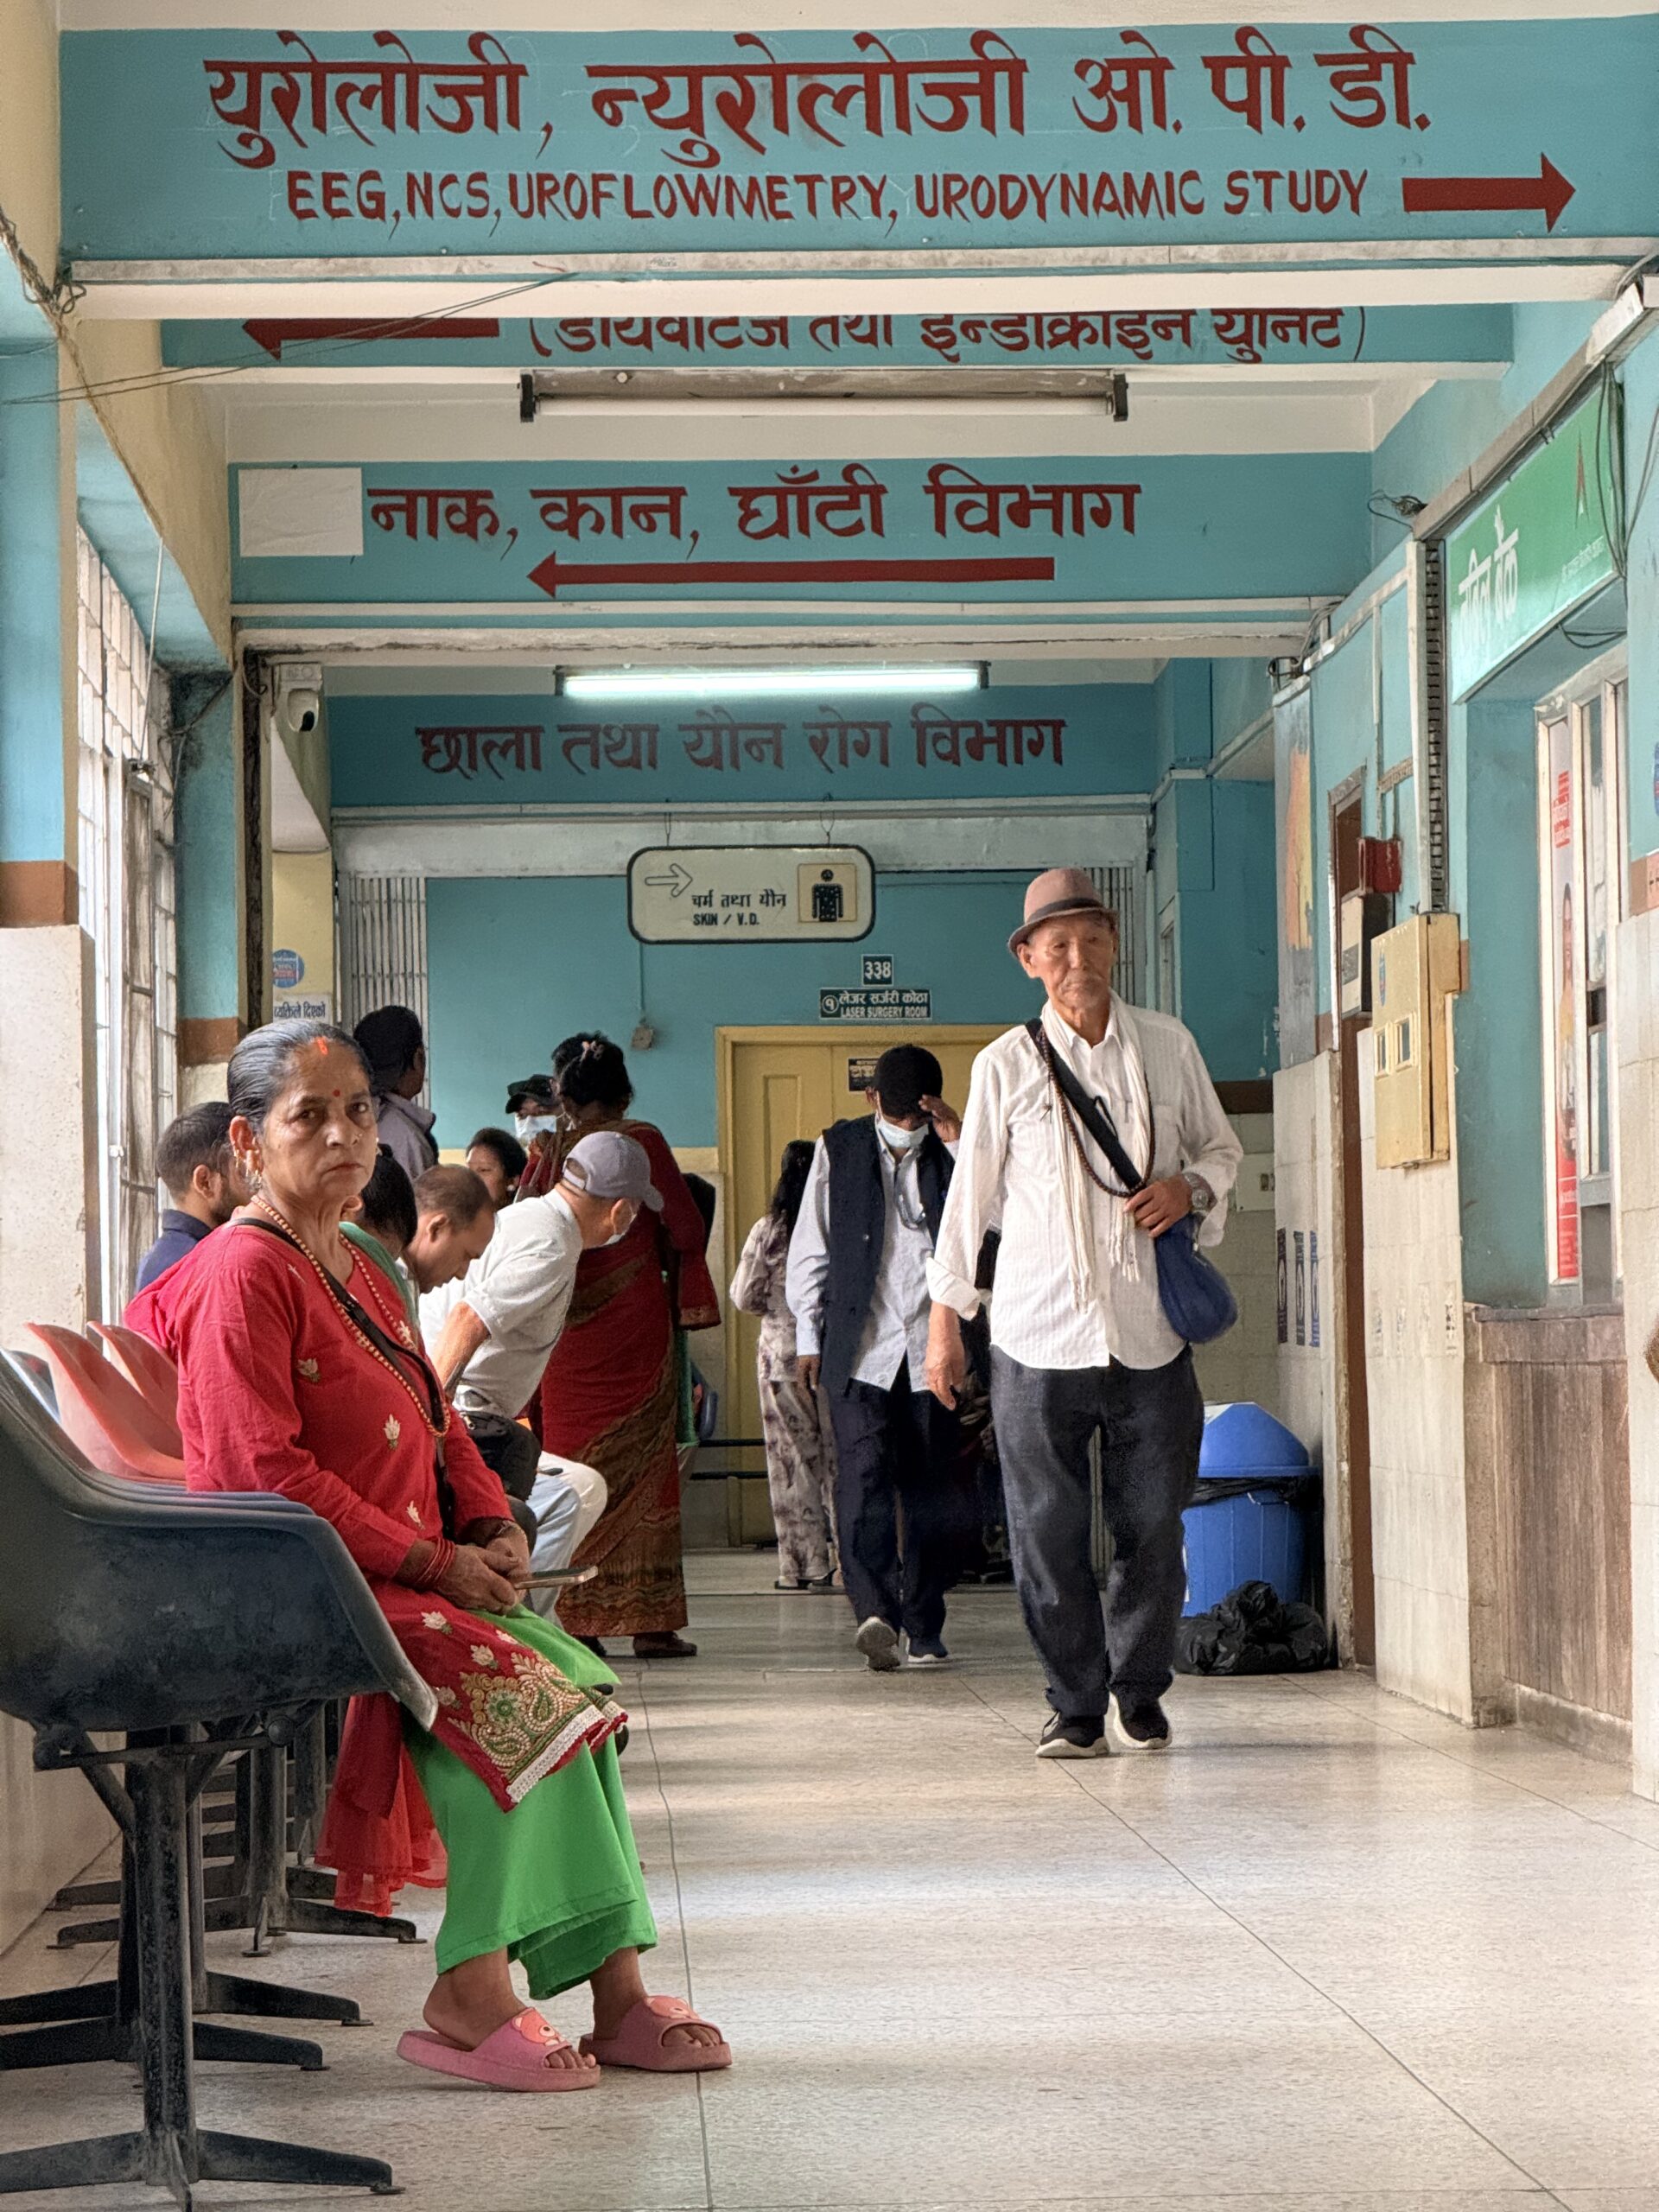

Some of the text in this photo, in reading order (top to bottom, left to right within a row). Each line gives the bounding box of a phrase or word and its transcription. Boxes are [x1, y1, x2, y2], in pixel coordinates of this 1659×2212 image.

[203, 23, 1431, 168] युरोलोजी, न्युरोलोजी ओ. पी. डी.
[916, 170, 1205, 222] URODYNAMIC
[1224, 168, 1369, 217] STUDY
[366, 462, 1141, 561] नाक, कान, घाँटी विभाग
[415, 702, 1068, 780] छाला तथा यौन रोग विभाग
[691, 889, 787, 908] चर्म तथा यौन
[693, 912, 718, 925] SKIN
[737, 912, 760, 925] V.D.
[839, 990, 867, 1005] लेजर
[902, 990, 928, 1004] कोठा
[841, 1006, 928, 1018] LASER SURGERY ROOM
